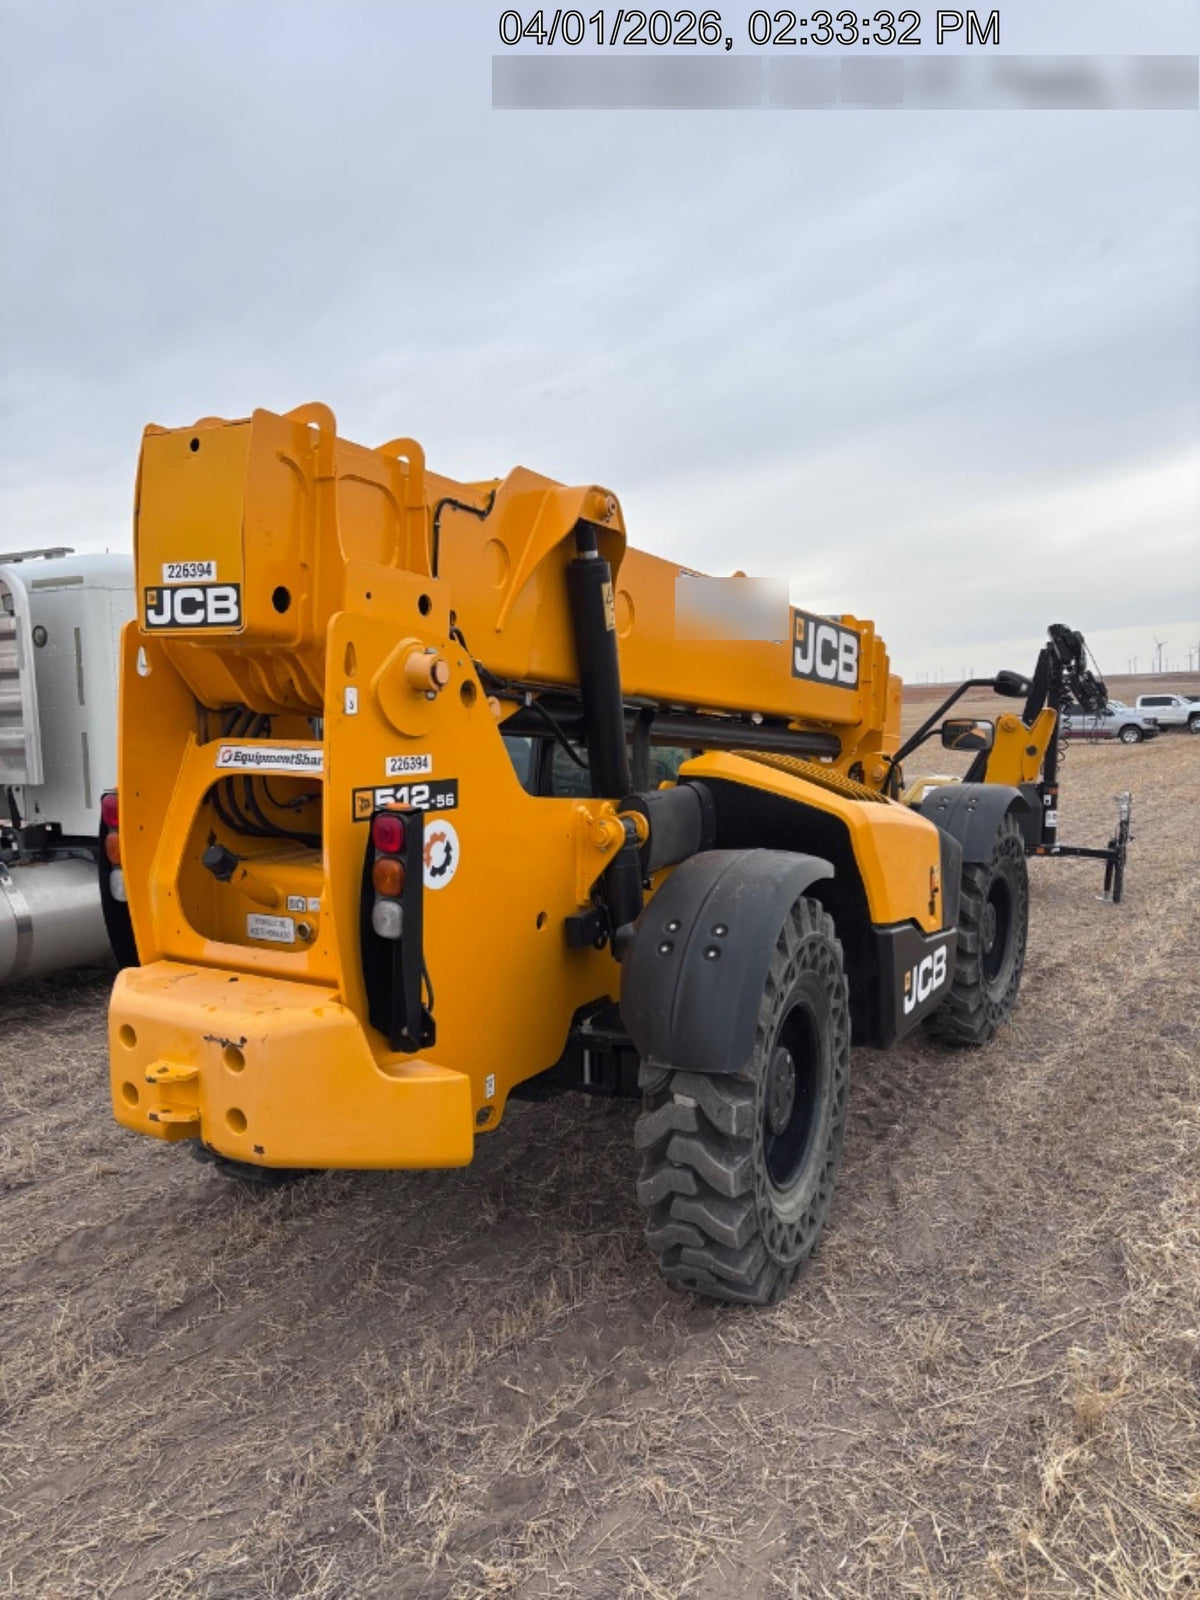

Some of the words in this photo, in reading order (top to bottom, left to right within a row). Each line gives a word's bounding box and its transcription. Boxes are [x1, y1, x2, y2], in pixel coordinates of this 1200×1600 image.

[168, 563, 212, 579] 226394
[147, 586, 239, 625] JCB
[793, 620, 860, 684] JCB
[233, 751, 323, 766] EquipmentShar
[390, 757, 428, 772] 226394
[903, 944, 947, 1014] JCB
